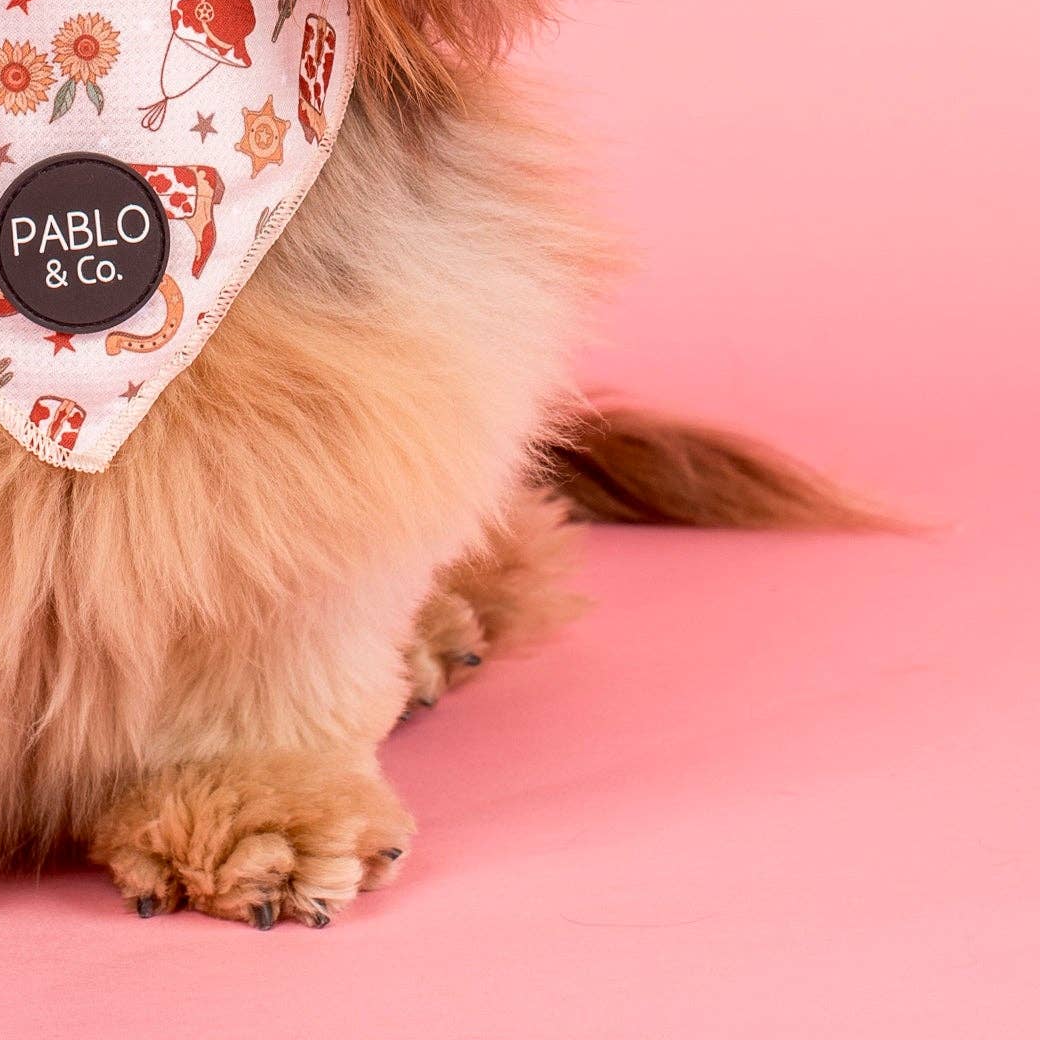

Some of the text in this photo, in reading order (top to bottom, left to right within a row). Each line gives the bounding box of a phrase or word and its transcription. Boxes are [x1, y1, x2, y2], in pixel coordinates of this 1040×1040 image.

[11, 203, 150, 257] PABLO
[45, 254, 124, 289] & Co.
